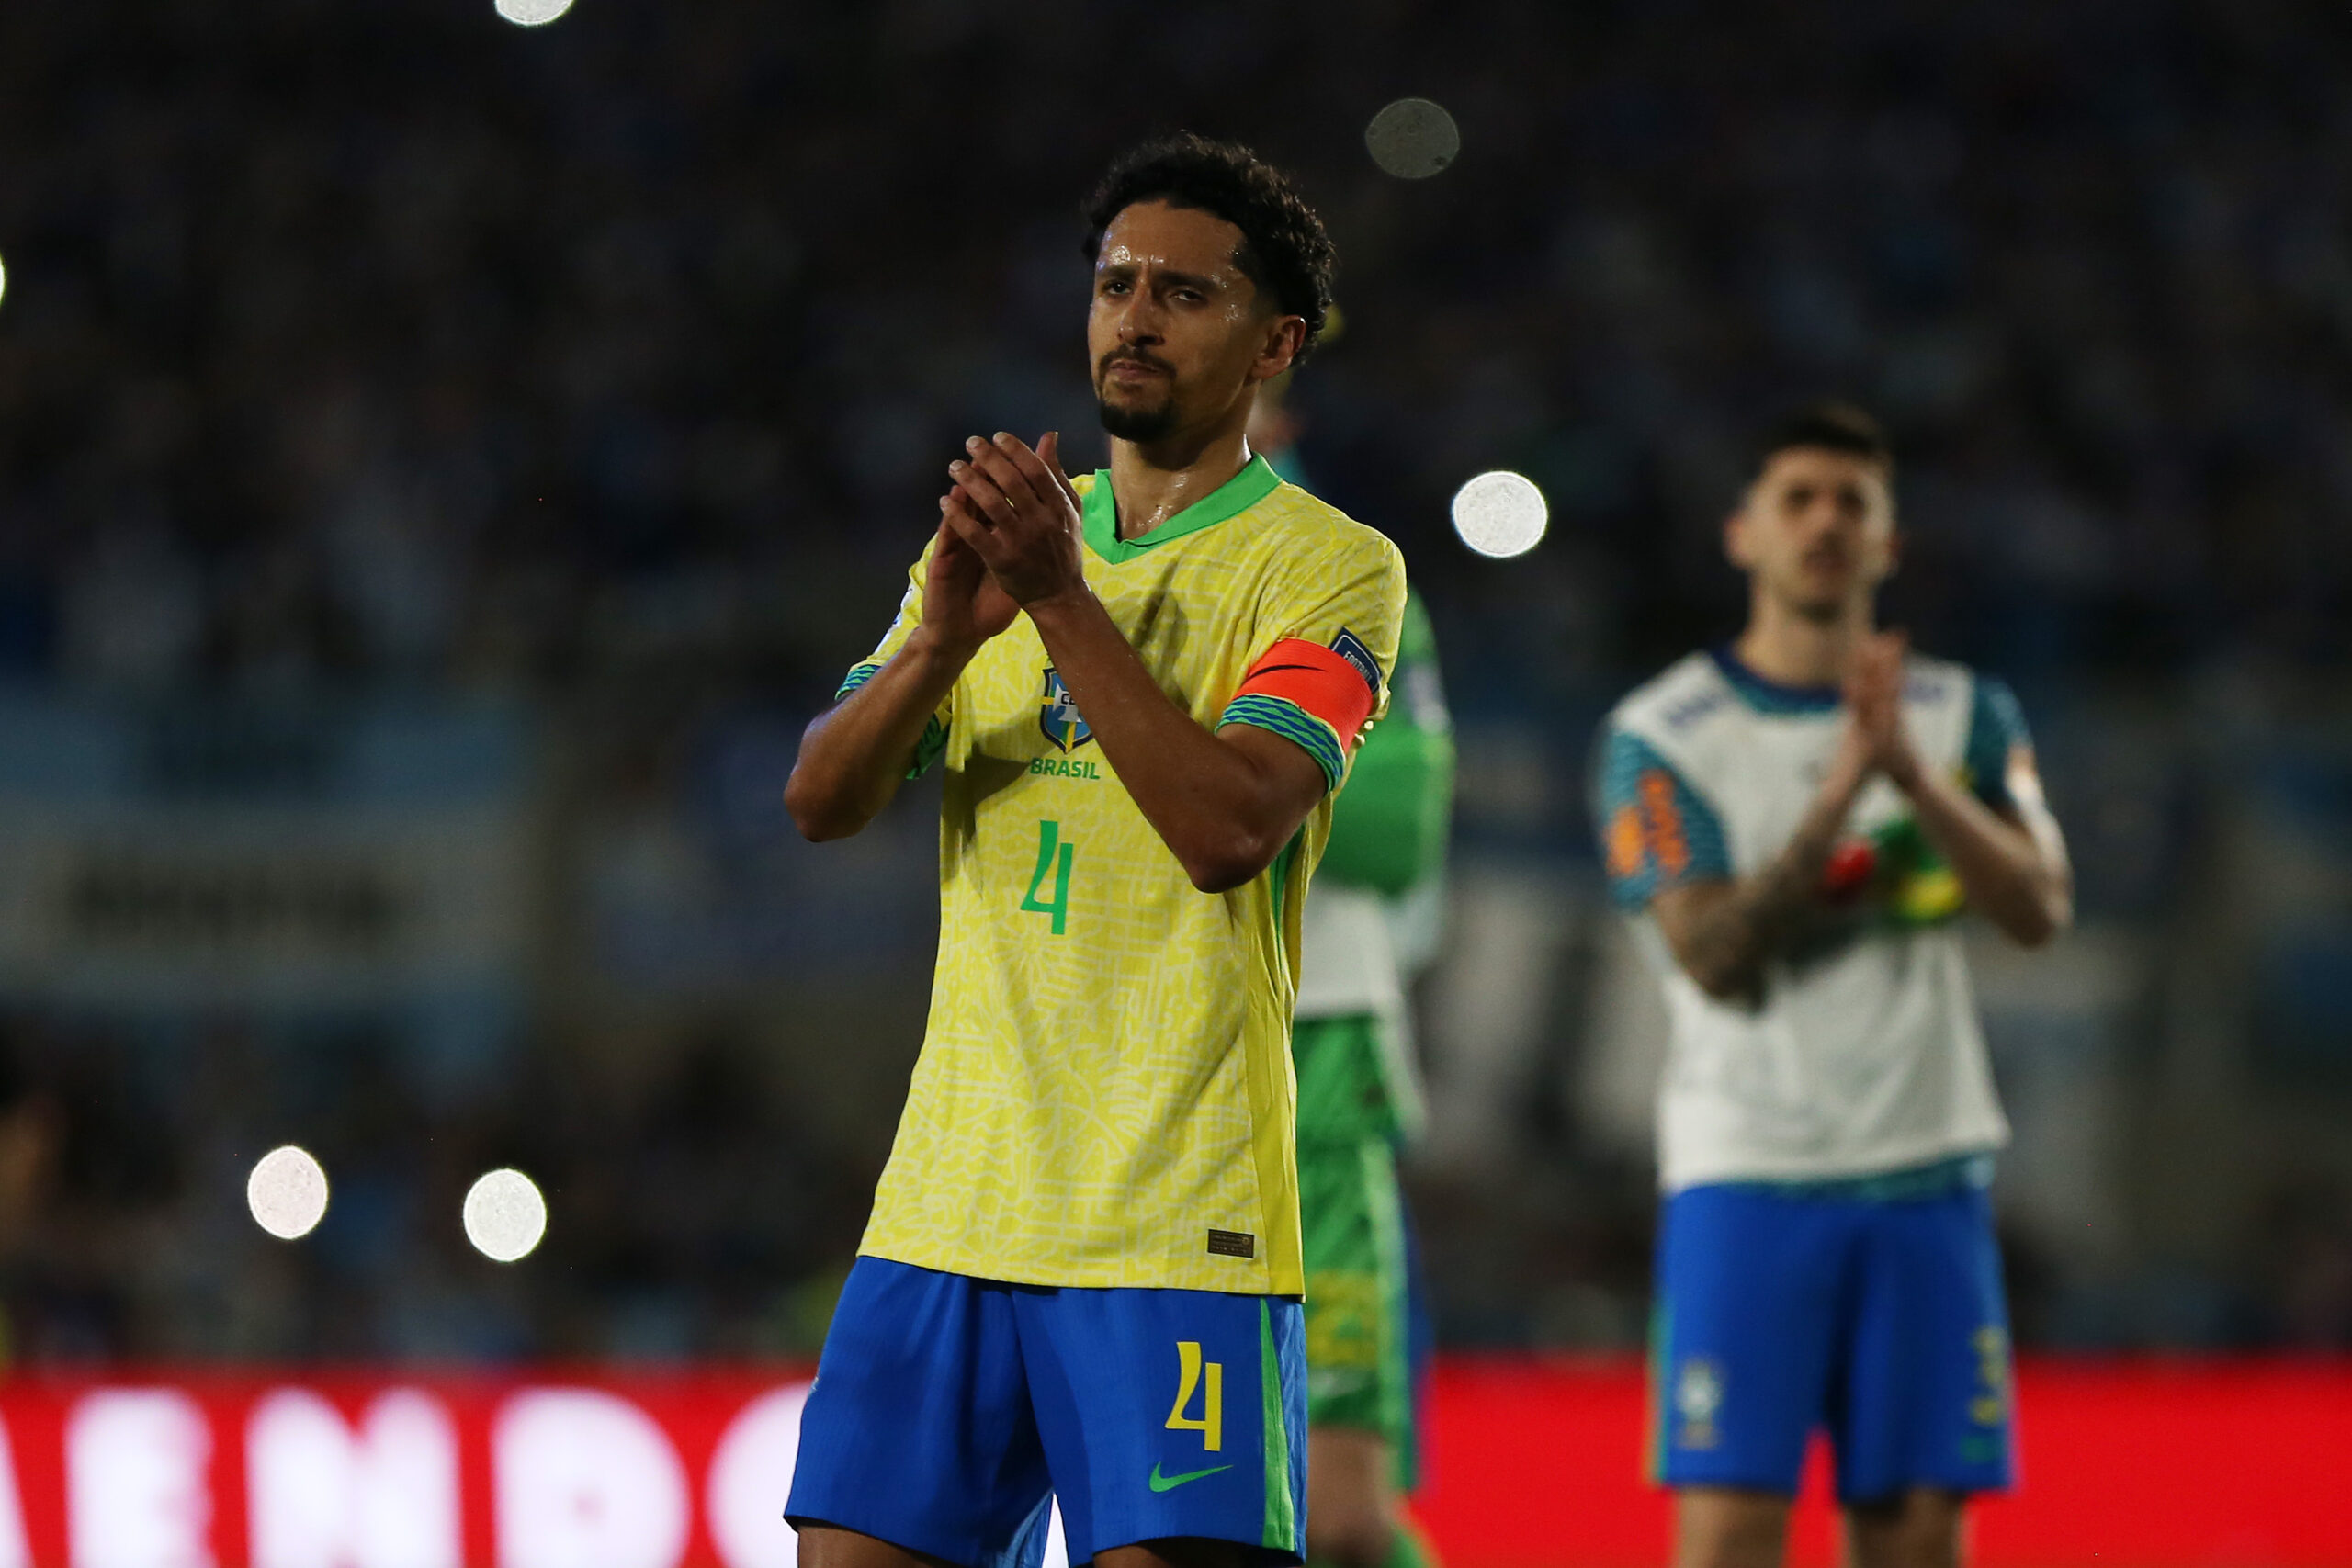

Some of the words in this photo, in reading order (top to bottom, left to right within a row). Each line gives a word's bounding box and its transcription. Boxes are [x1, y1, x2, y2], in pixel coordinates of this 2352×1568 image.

[1029, 758, 1101, 780] BRASIL
[1020, 819, 1074, 935] 4
[1164, 1341, 1222, 1451] 4
